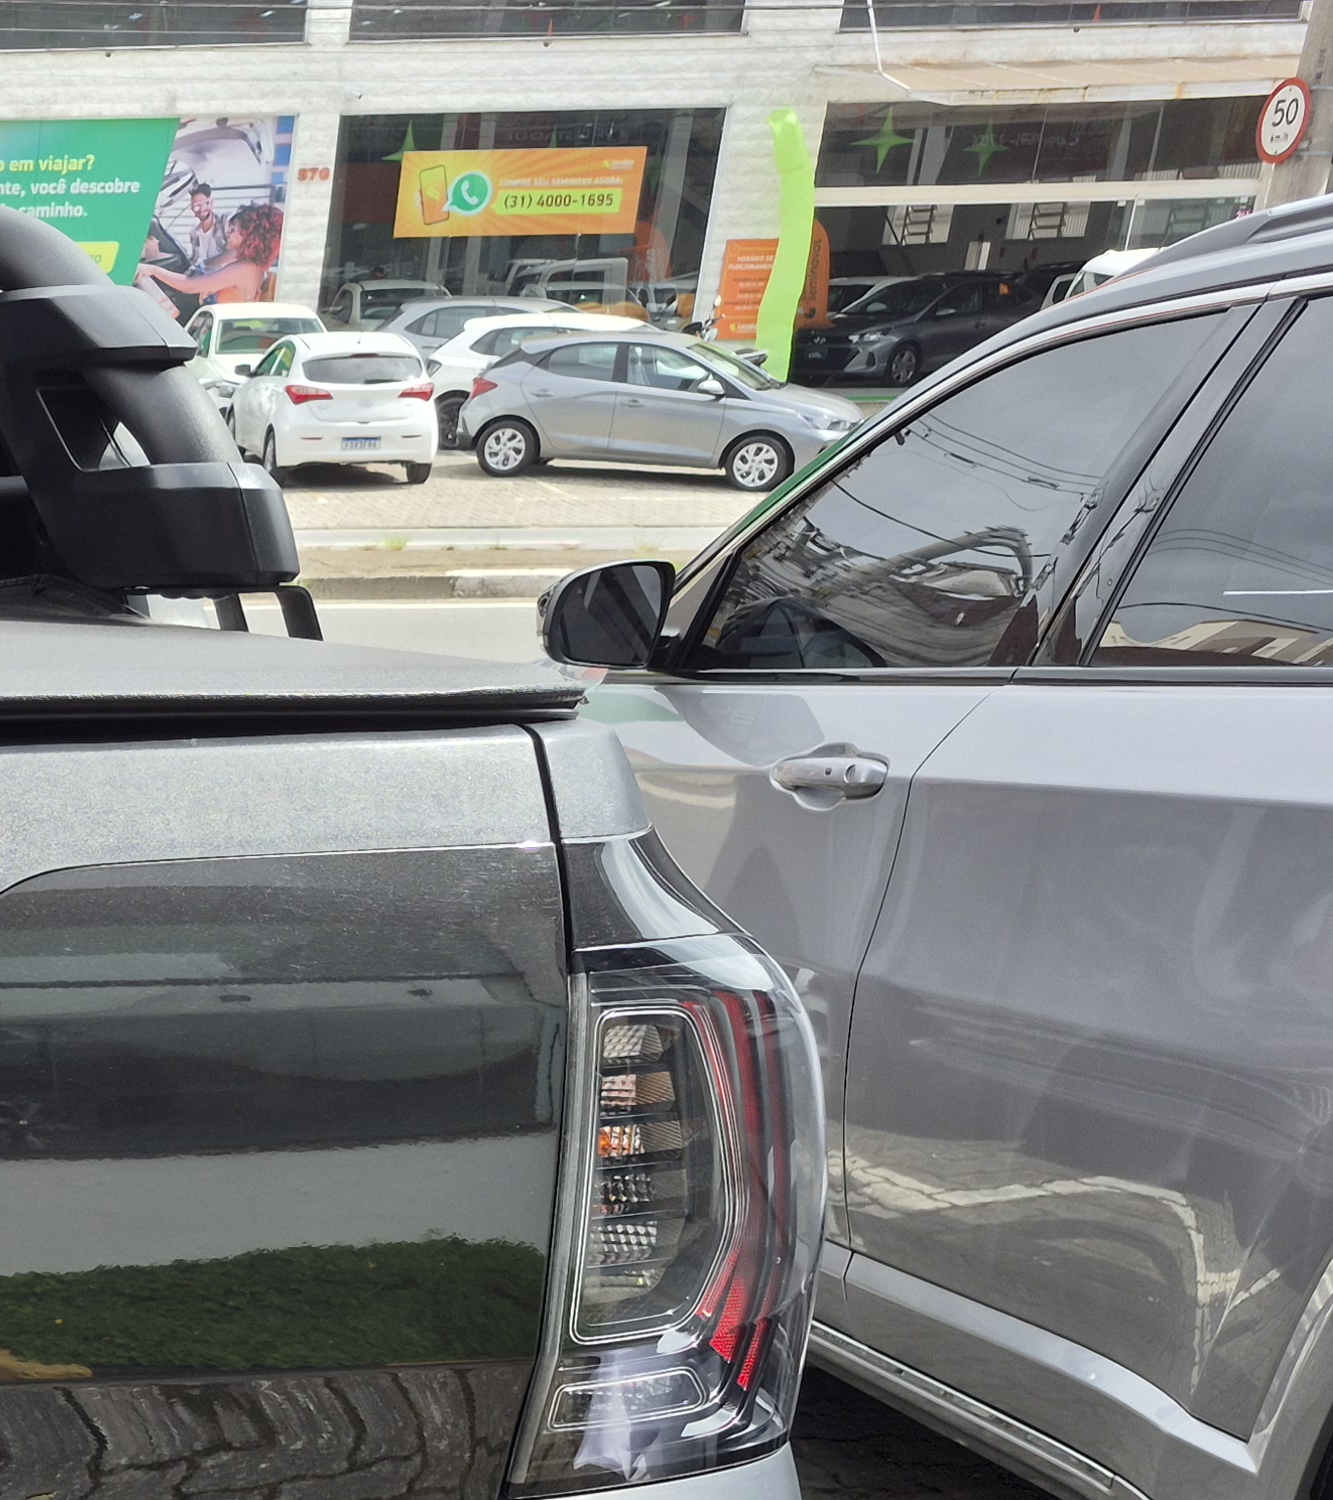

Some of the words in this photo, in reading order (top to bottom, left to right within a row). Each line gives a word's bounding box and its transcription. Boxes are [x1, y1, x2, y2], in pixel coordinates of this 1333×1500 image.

[1271, 97, 1299, 128] 50
[9, 159, 34, 171] em
[39, 154, 95, 175] viajar?
[31, 178, 66, 195] você
[70, 178, 141, 195] descobre
[504, 194, 533, 210] (31)
[537, 193, 615, 208] 4000-1695
